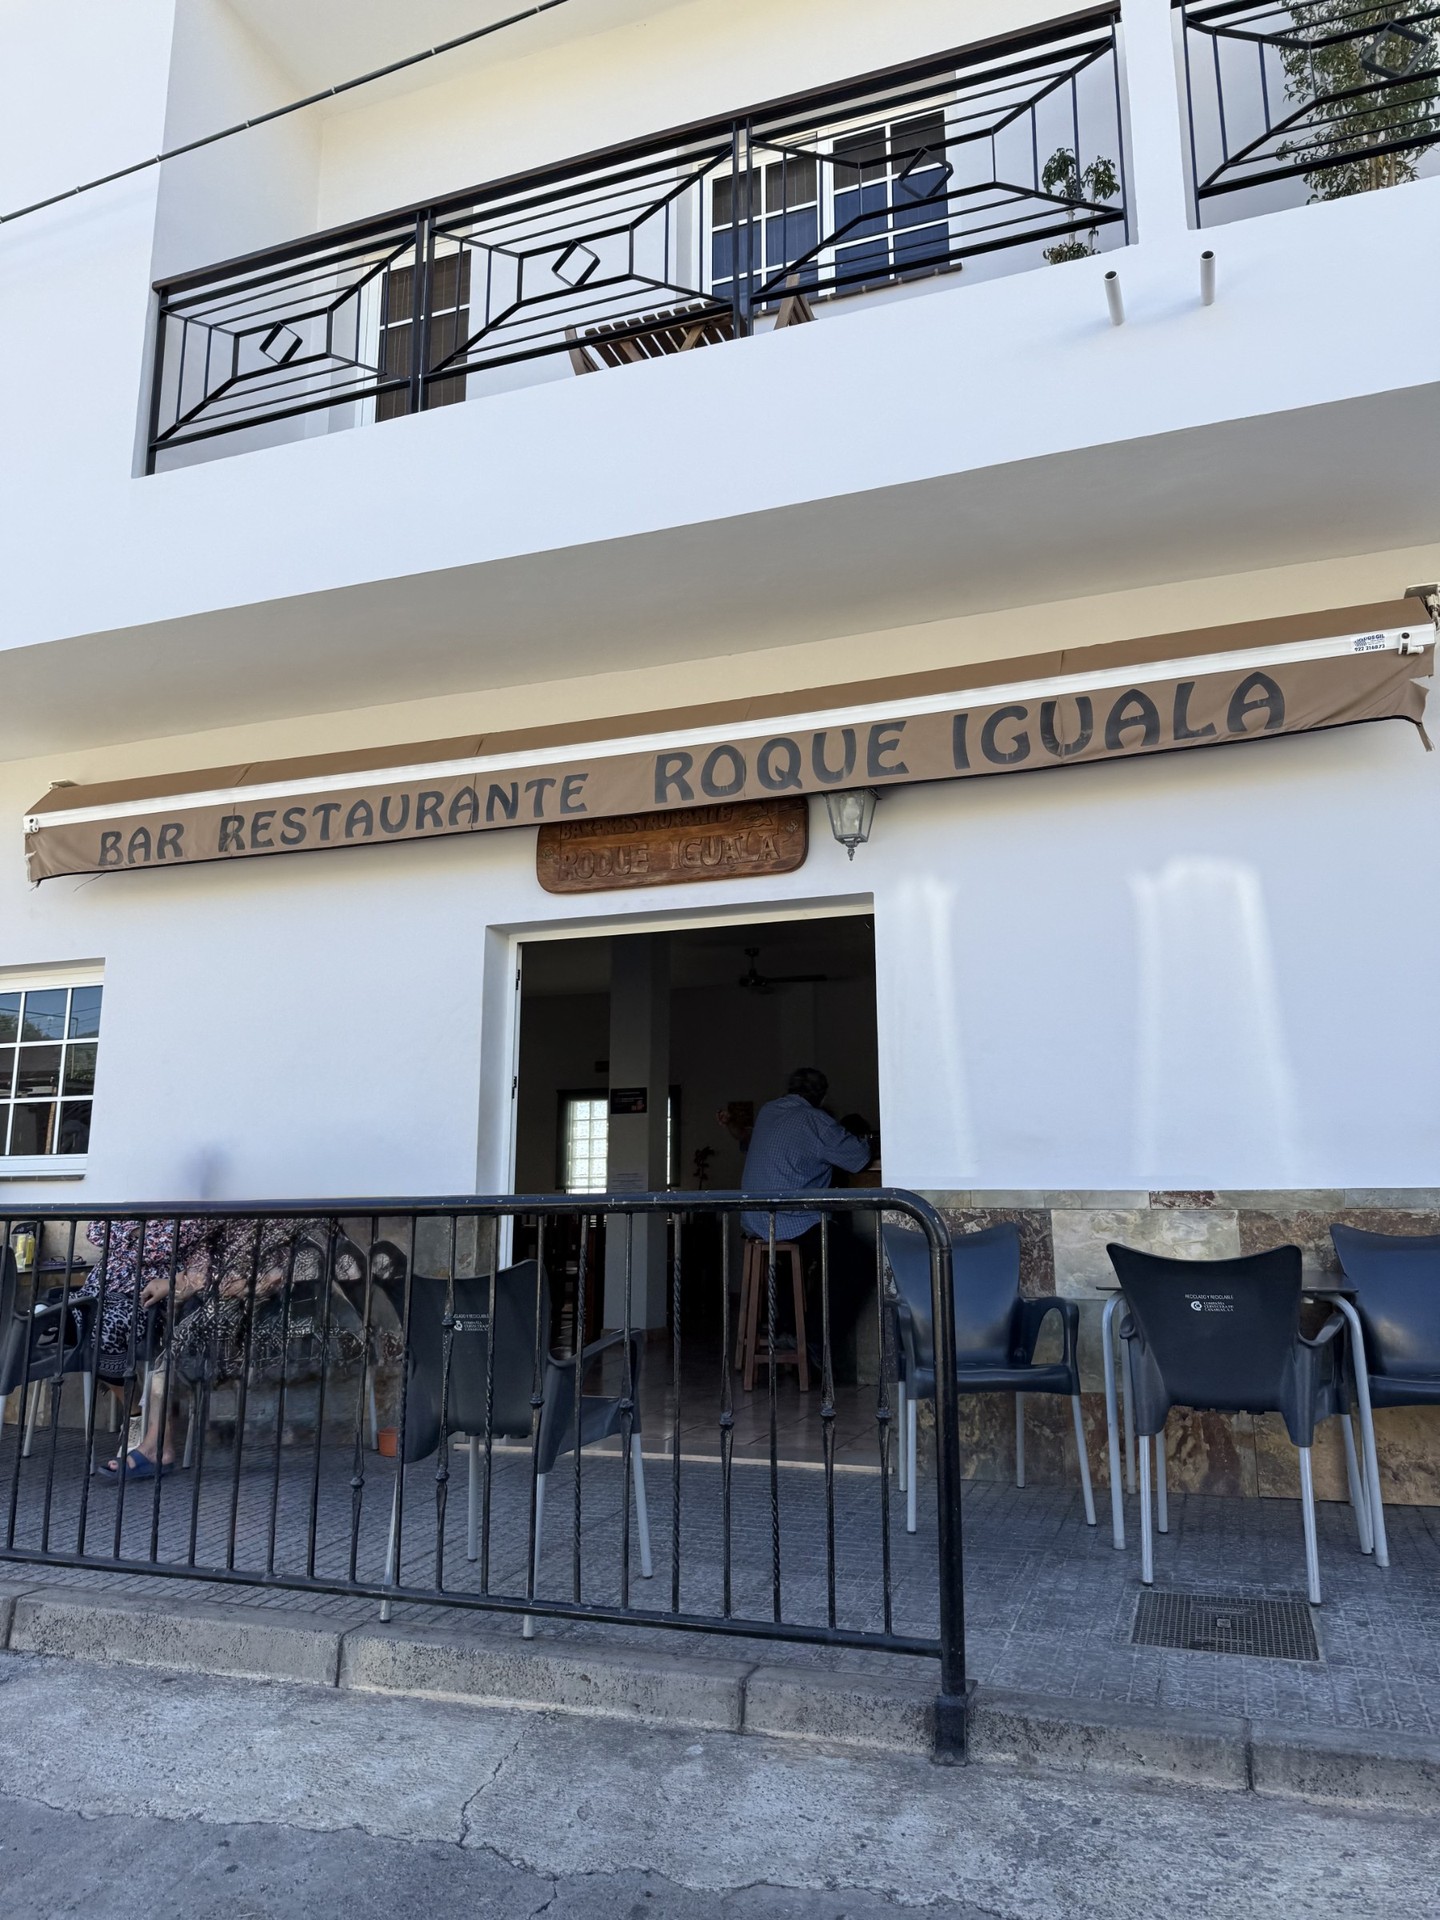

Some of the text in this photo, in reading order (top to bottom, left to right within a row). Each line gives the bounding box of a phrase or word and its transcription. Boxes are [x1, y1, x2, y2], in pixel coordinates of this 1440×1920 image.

[98, 671, 1287, 867] BAR RESTAURANTE ROQUE IGUALA
[558, 831, 780, 880] ROQUE IGUALA
